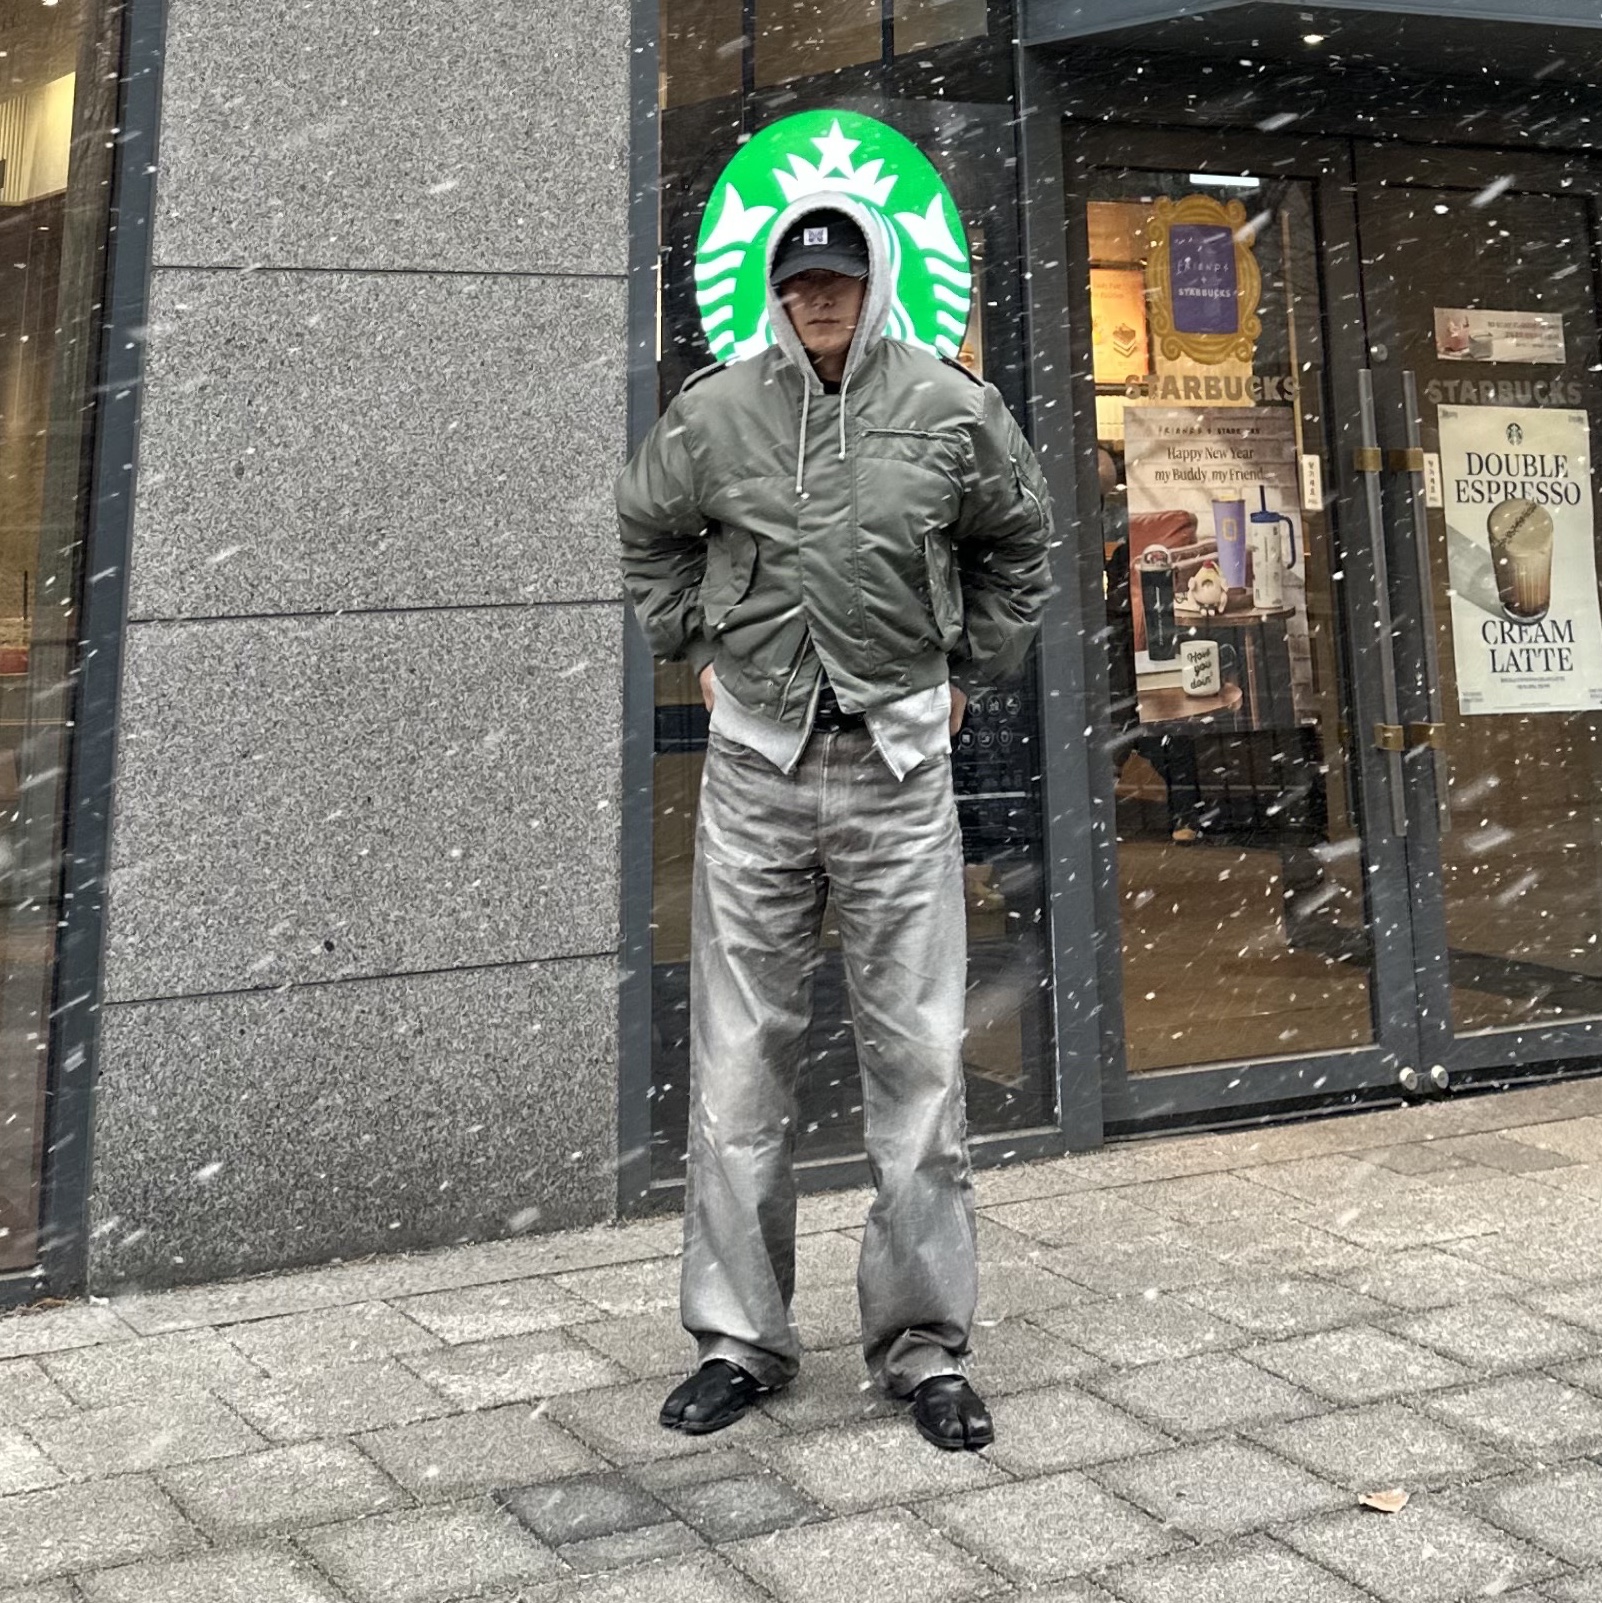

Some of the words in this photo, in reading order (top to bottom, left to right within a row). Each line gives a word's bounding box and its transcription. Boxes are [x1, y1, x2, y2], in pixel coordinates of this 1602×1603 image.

[1178, 288, 1231, 298] STARBUCKS
[1125, 374, 1297, 401] STARBUCKS
[1427, 379, 1583, 405] STARBUCKS
[1167, 447, 1203, 462] Happy
[1205, 447, 1228, 460] New
[1230, 447, 1255, 460] Year
[1466, 452, 1568, 478] DOUBLE
[1155, 470, 1171, 483] my
[1212, 470, 1228, 483] my
[1455, 479, 1581, 505] ESPRESSO
[1482, 619, 1575, 645] CREAM
[1194, 661, 1212, 677] you
[1490, 647, 1573, 673] LATTE
